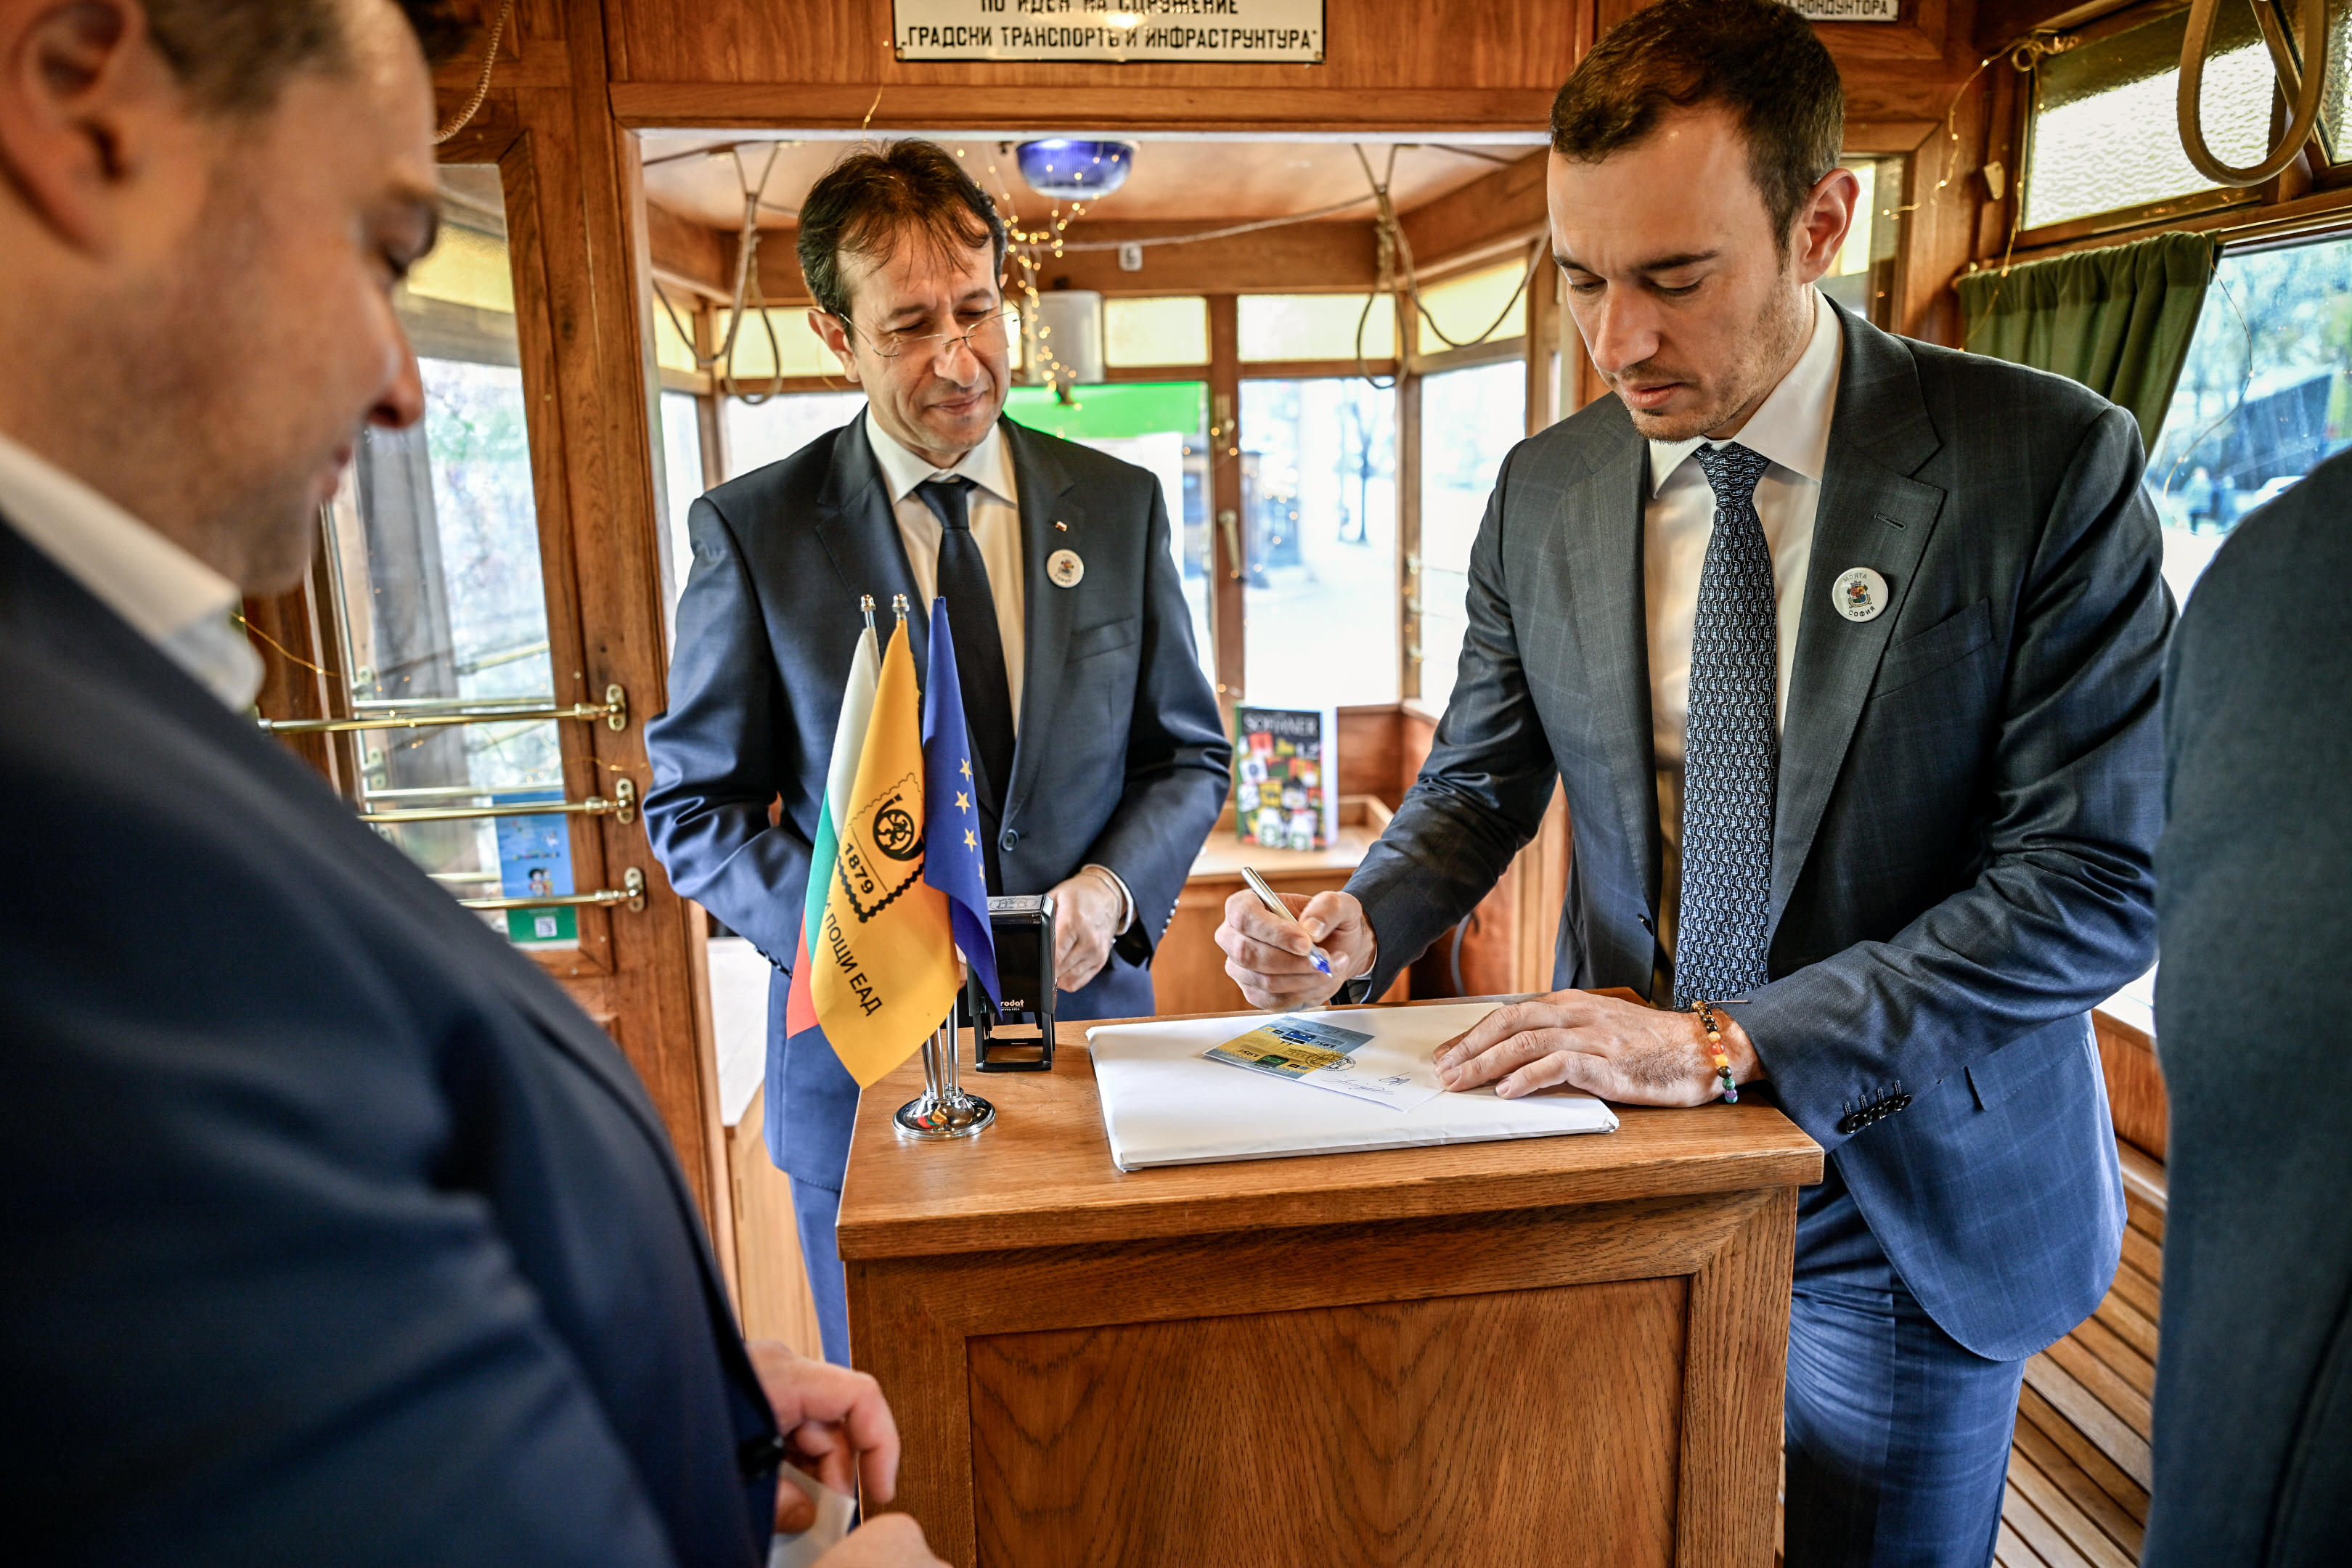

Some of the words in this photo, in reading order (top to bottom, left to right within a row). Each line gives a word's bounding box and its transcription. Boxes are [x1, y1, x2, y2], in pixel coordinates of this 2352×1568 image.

[981, 0, 1005, 12] ПО
[1126, 27, 1138, 47] И
[1843, 573, 1867, 583] МОЯТА
[1848, 605, 1875, 617] СОФИЯ
[846, 843, 874, 894] 1879
[826, 912, 857, 973] ПОЩИ
[849, 972, 883, 1017] ЕАД
